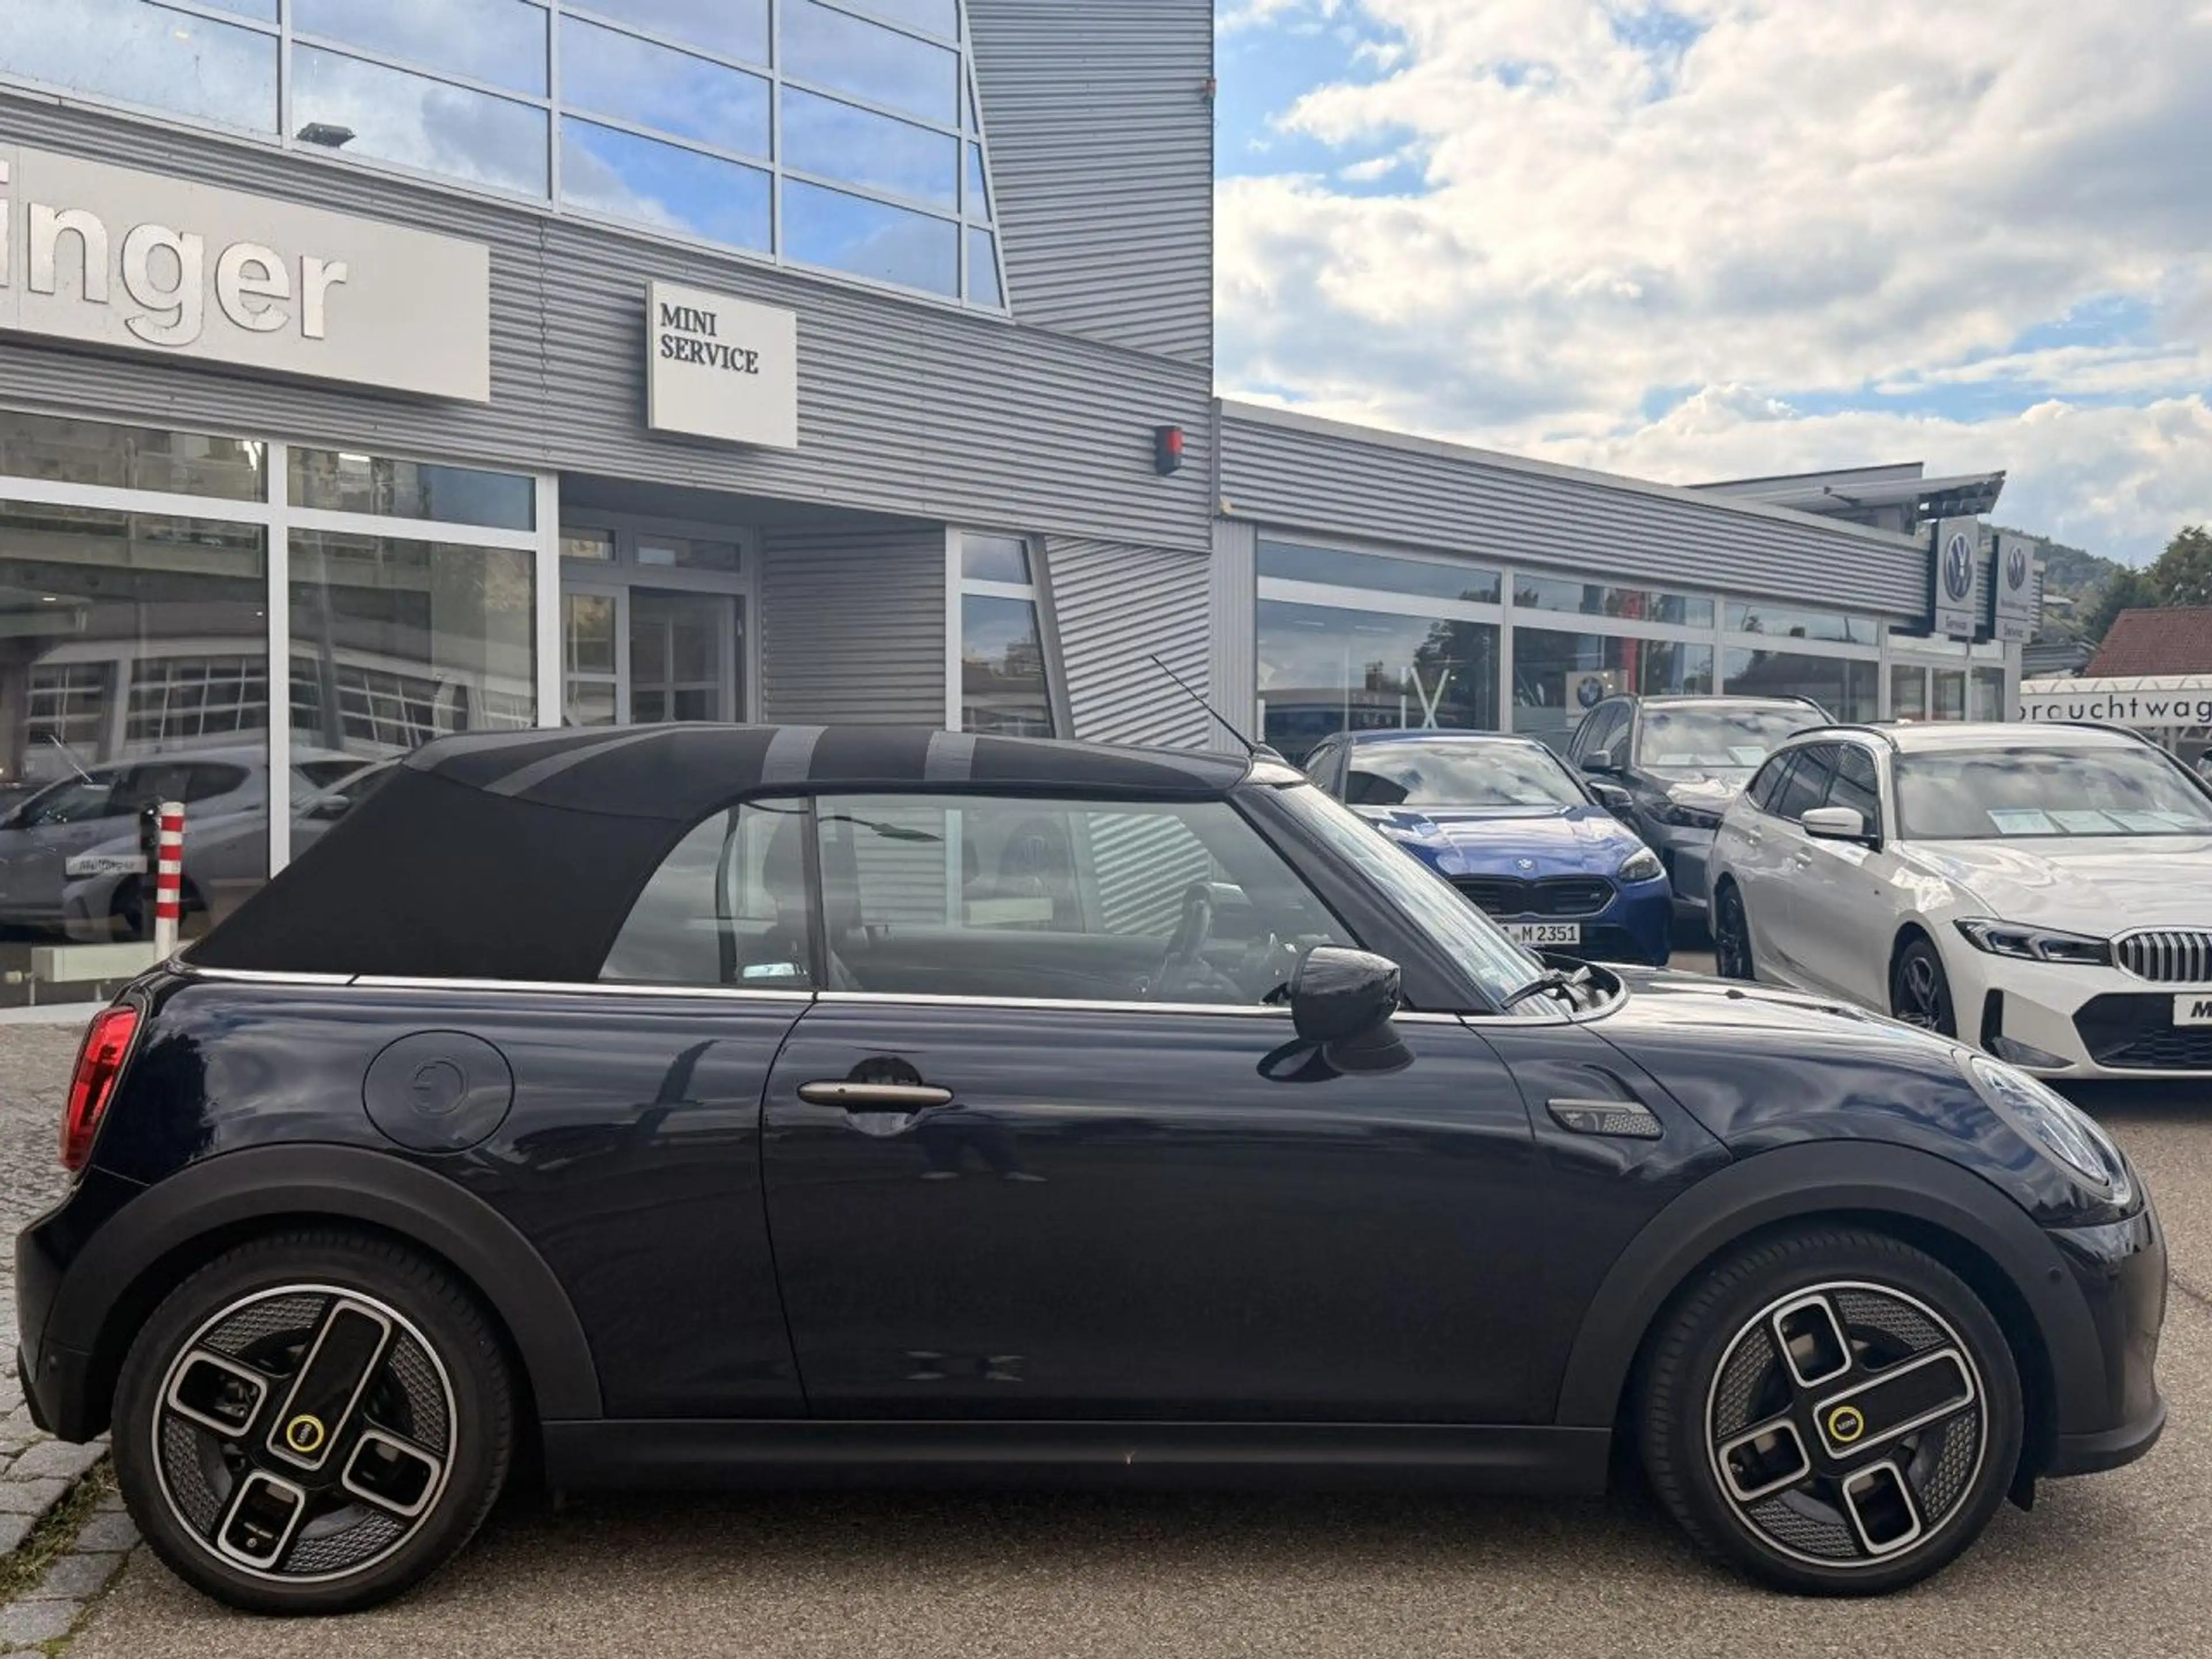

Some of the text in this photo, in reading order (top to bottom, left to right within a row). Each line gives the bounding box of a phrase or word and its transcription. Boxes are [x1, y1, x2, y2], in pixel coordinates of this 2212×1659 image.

[660, 302, 717, 337] MINI
[660, 333, 759, 374] SERVICE
[1522, 926, 1577, 941] M 2351
